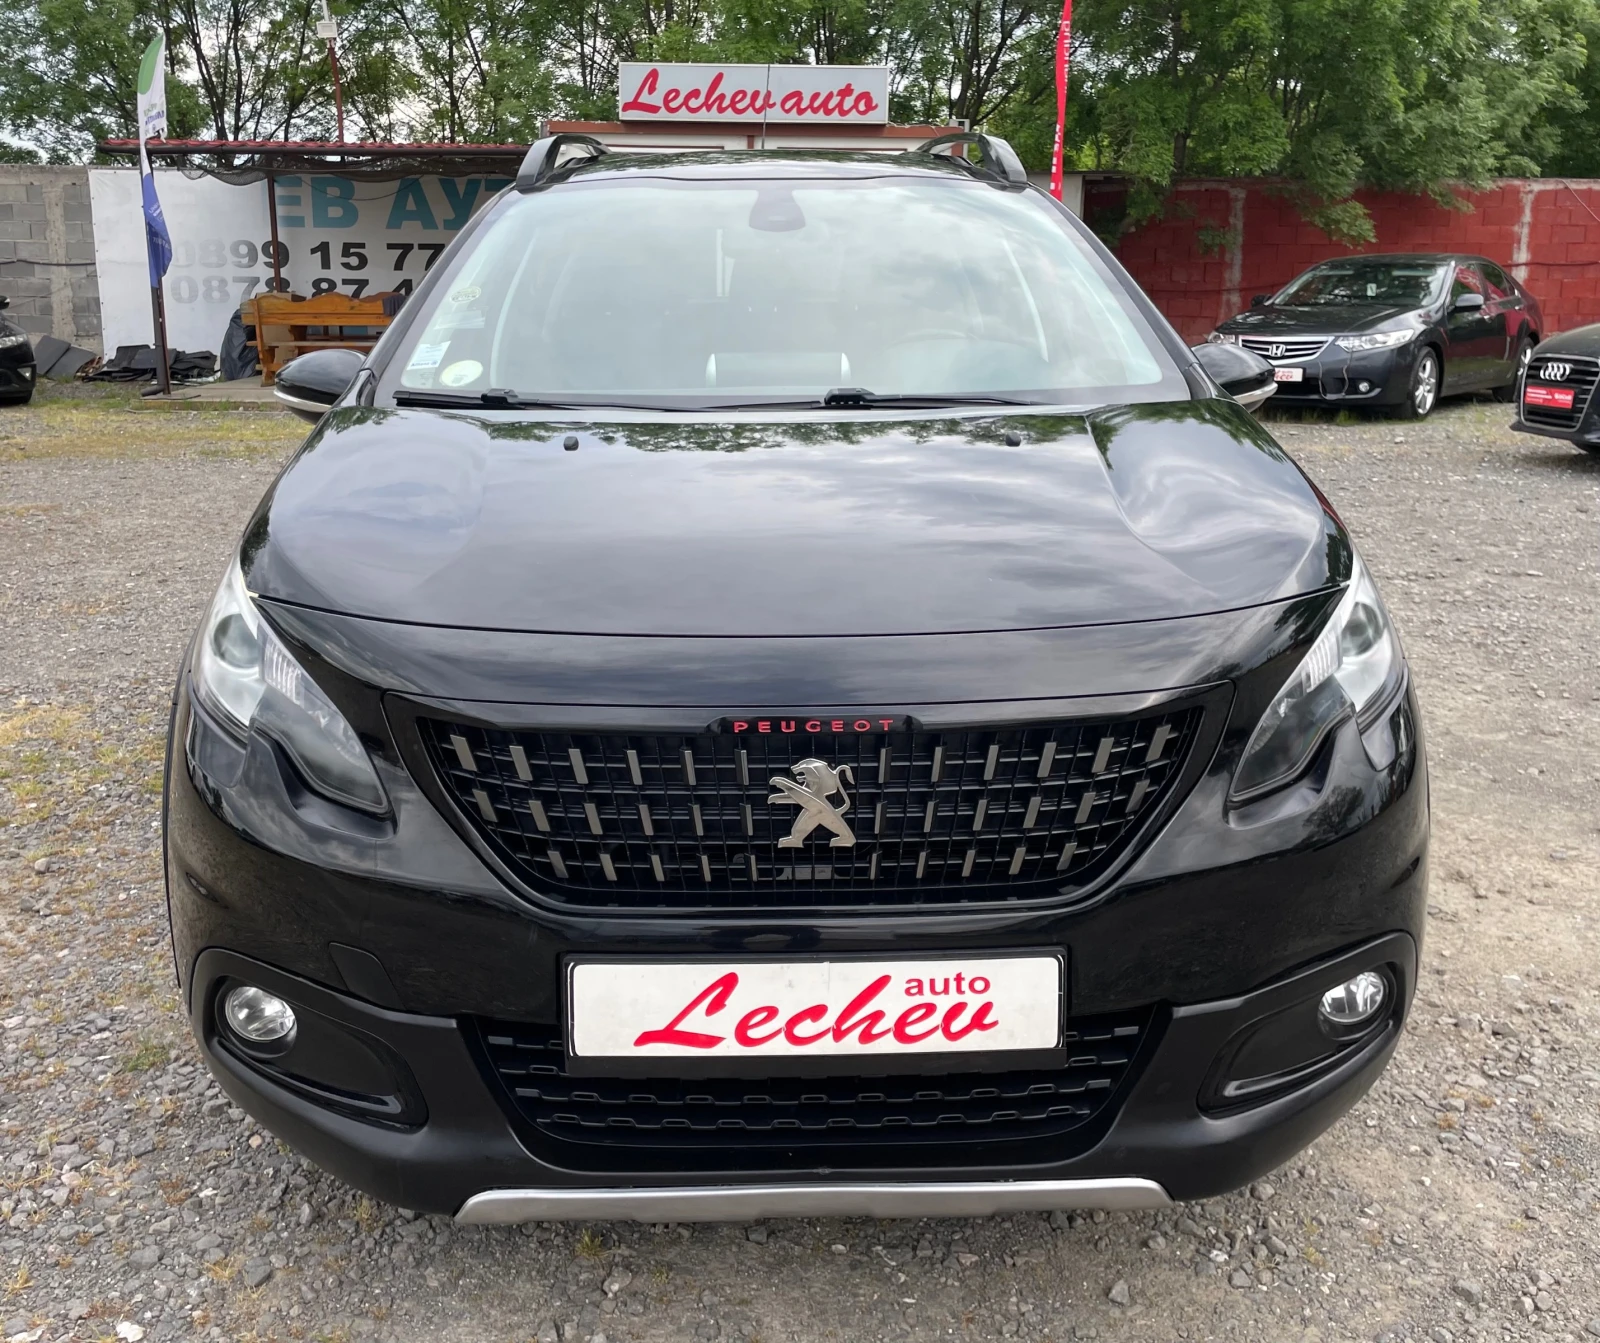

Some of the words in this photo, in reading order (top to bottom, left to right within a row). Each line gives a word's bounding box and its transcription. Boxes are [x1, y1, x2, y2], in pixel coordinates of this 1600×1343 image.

[621, 68, 776, 115] Lechev
[780, 83, 879, 117] auto
[173, 239, 290, 269] 0899
[310, 241, 369, 271] 15
[733, 720, 894, 733] PEUGEOT
[904, 972, 991, 997] auto
[633, 972, 999, 1049] Lechev
